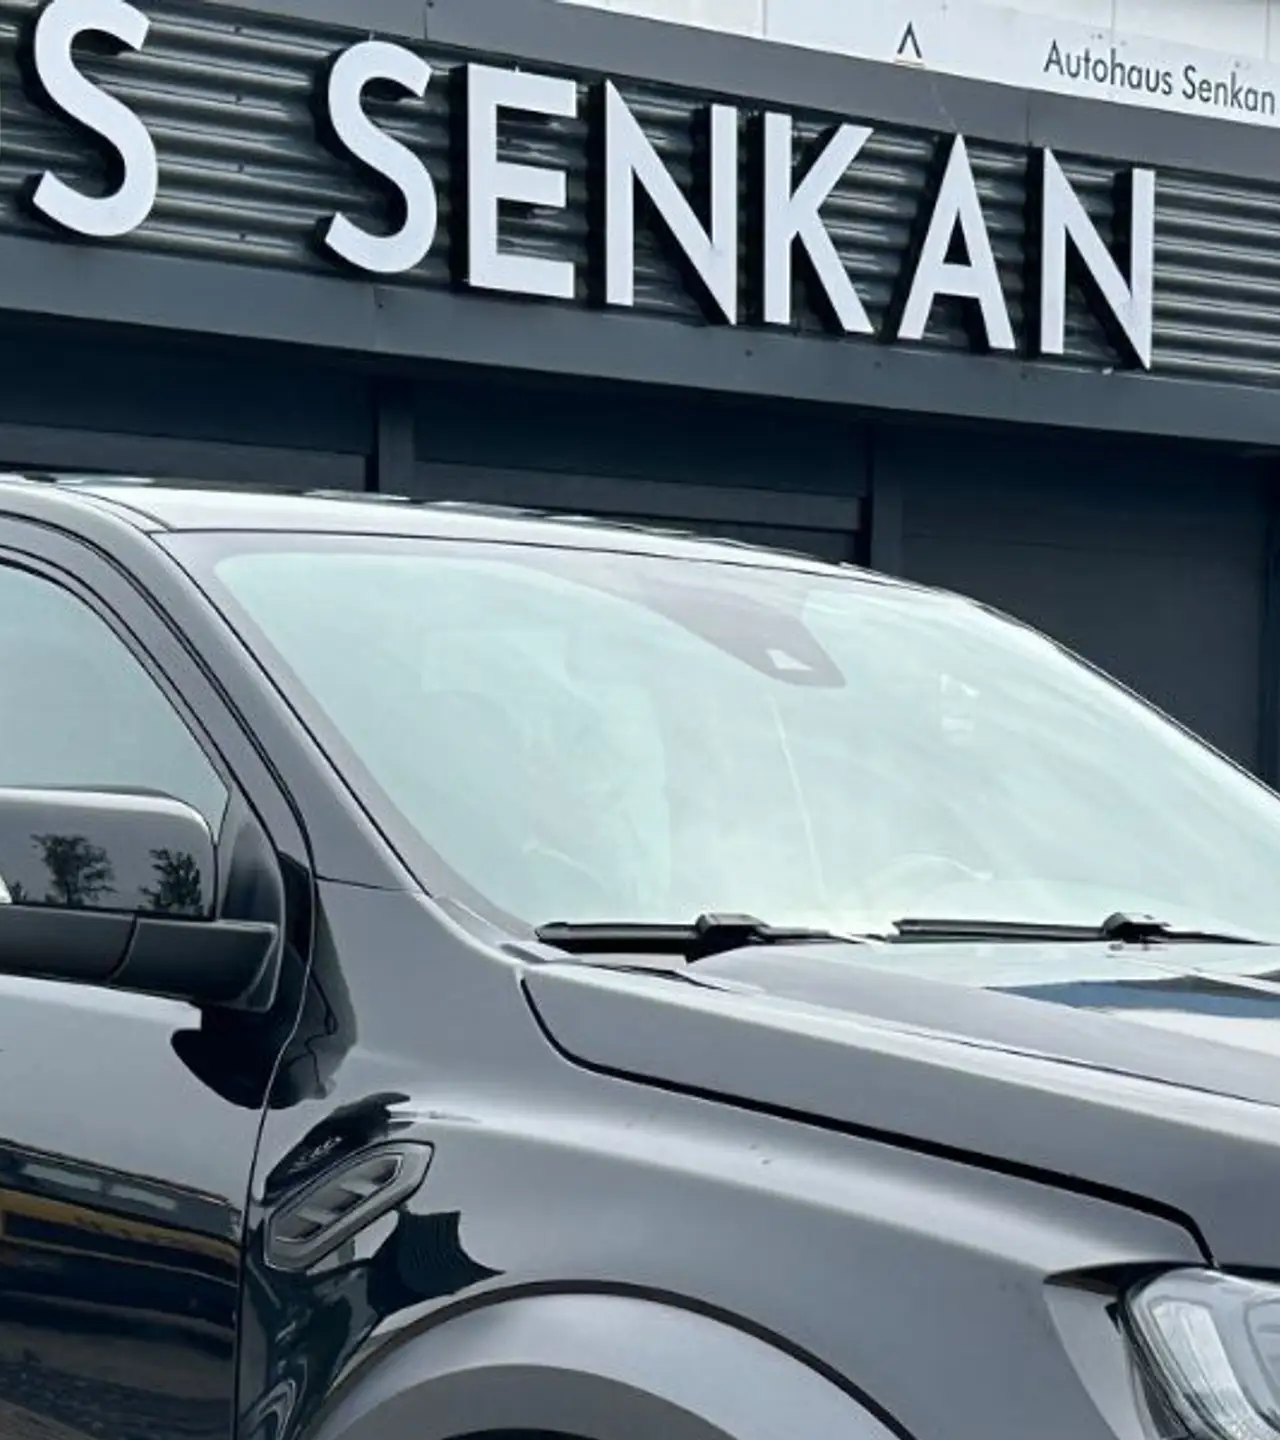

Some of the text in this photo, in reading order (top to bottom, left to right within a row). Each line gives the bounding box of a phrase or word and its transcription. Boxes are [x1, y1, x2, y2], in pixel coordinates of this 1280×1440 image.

[1043, 39, 1173, 98] Autohaus
[1181, 64, 1276, 117] Senkan
[323, 40, 1156, 370] SENKAN
